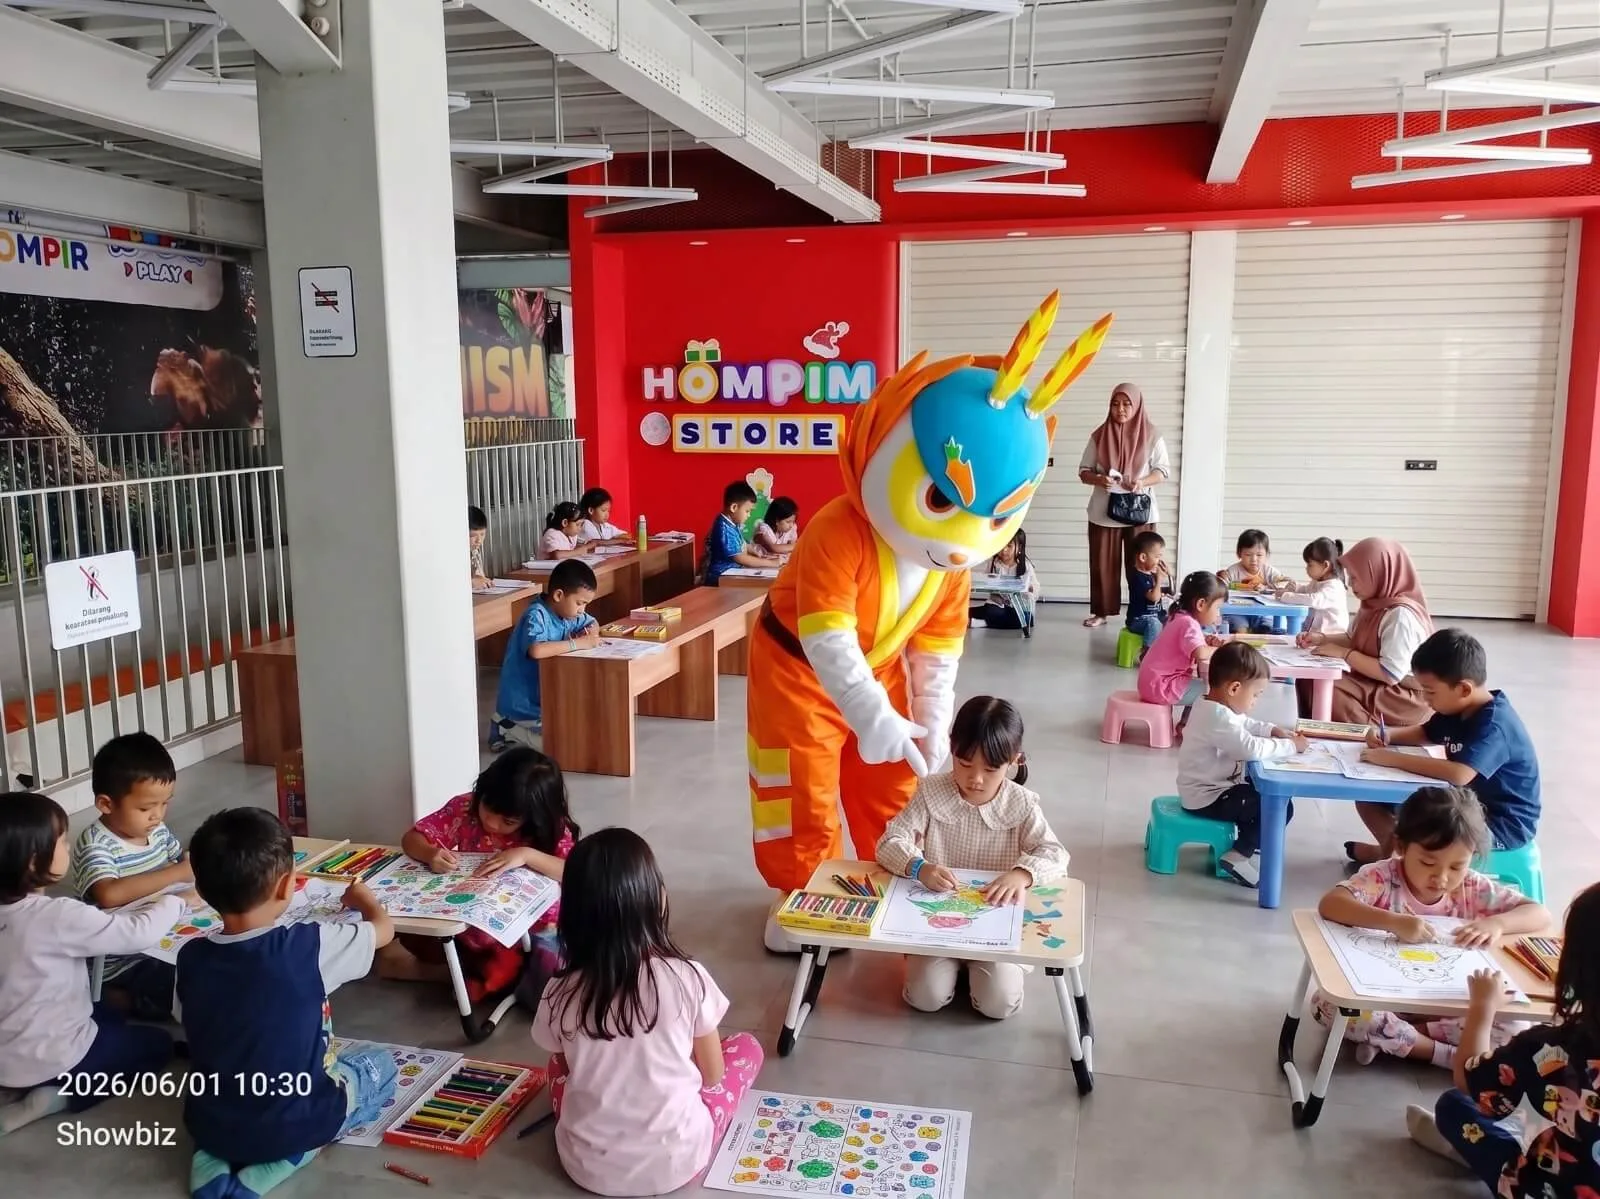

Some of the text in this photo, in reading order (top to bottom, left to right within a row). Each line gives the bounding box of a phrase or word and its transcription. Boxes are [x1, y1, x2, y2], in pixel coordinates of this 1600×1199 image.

[136, 261, 182, 283] PLAY
[642, 359, 876, 406] HOMPIM
[681, 422, 833, 446] STORE
[82, 605, 111, 617] Dilarang
